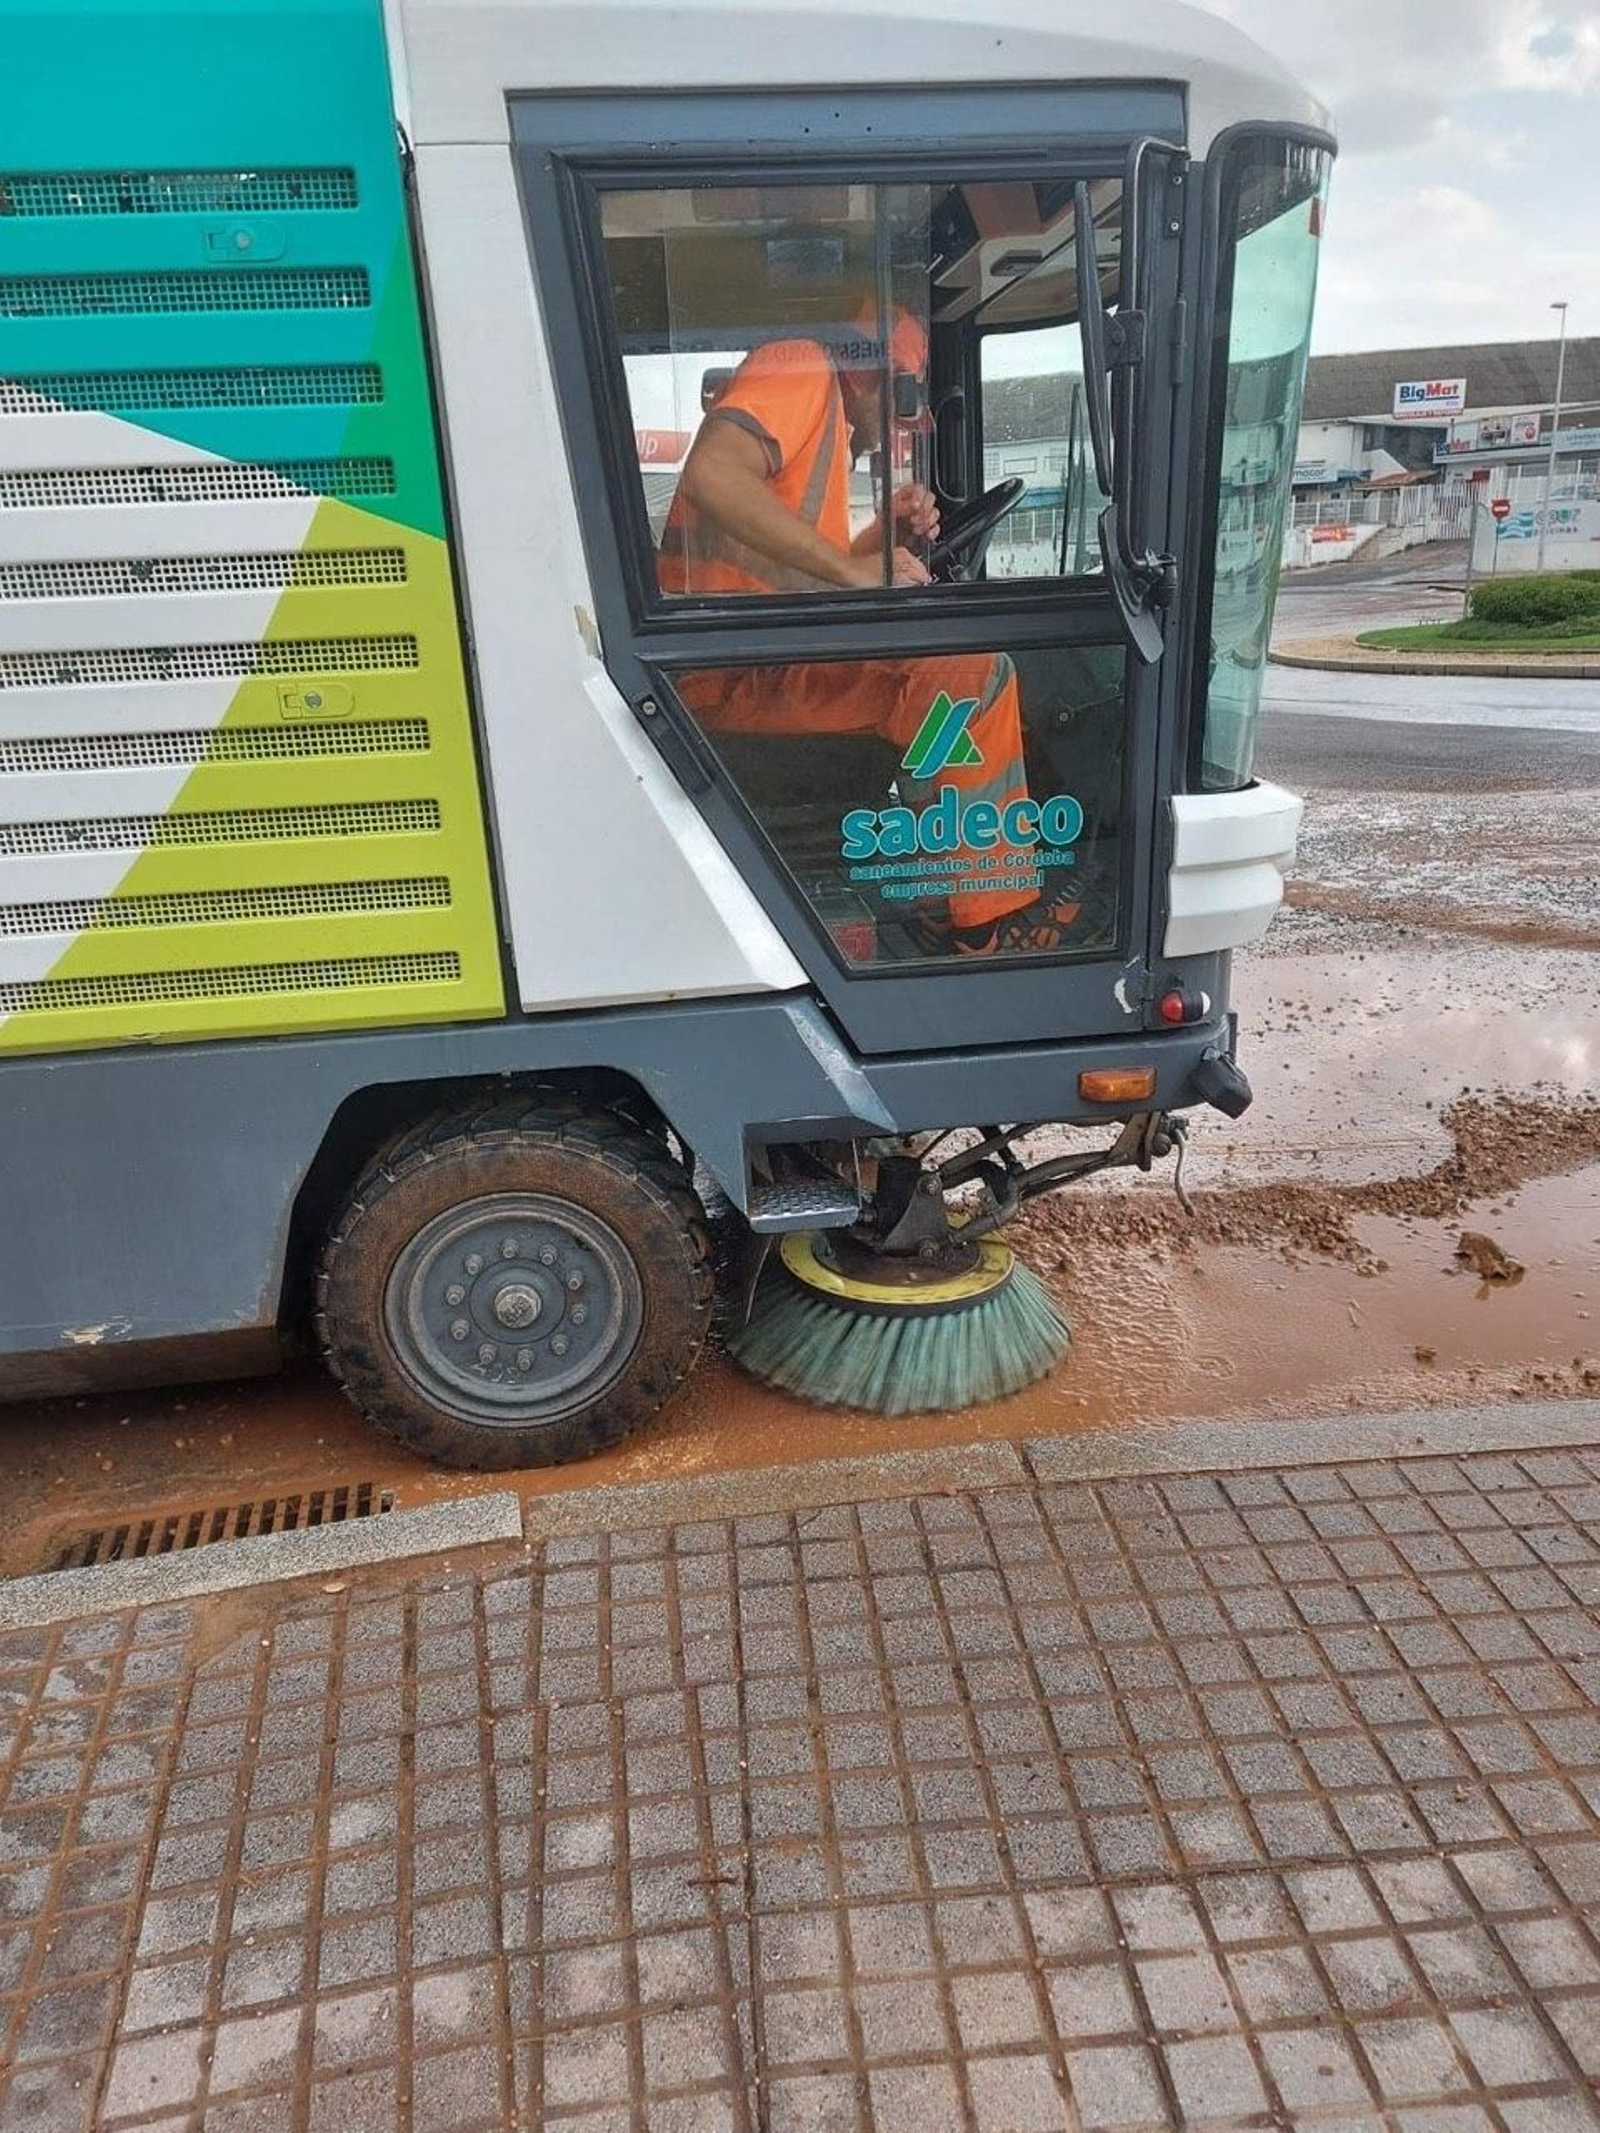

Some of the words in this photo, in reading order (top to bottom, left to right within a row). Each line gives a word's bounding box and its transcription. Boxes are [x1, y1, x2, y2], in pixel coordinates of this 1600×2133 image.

[1399, 382, 1459, 402] BigMat
[842, 785, 1083, 859] sadeco
[850, 856, 972, 881] saneamientos
[977, 854, 997, 871] de
[1003, 849, 1075, 868] Córdoba
[881, 880, 955, 900] empresa
[959, 870, 1045, 892] municipal
